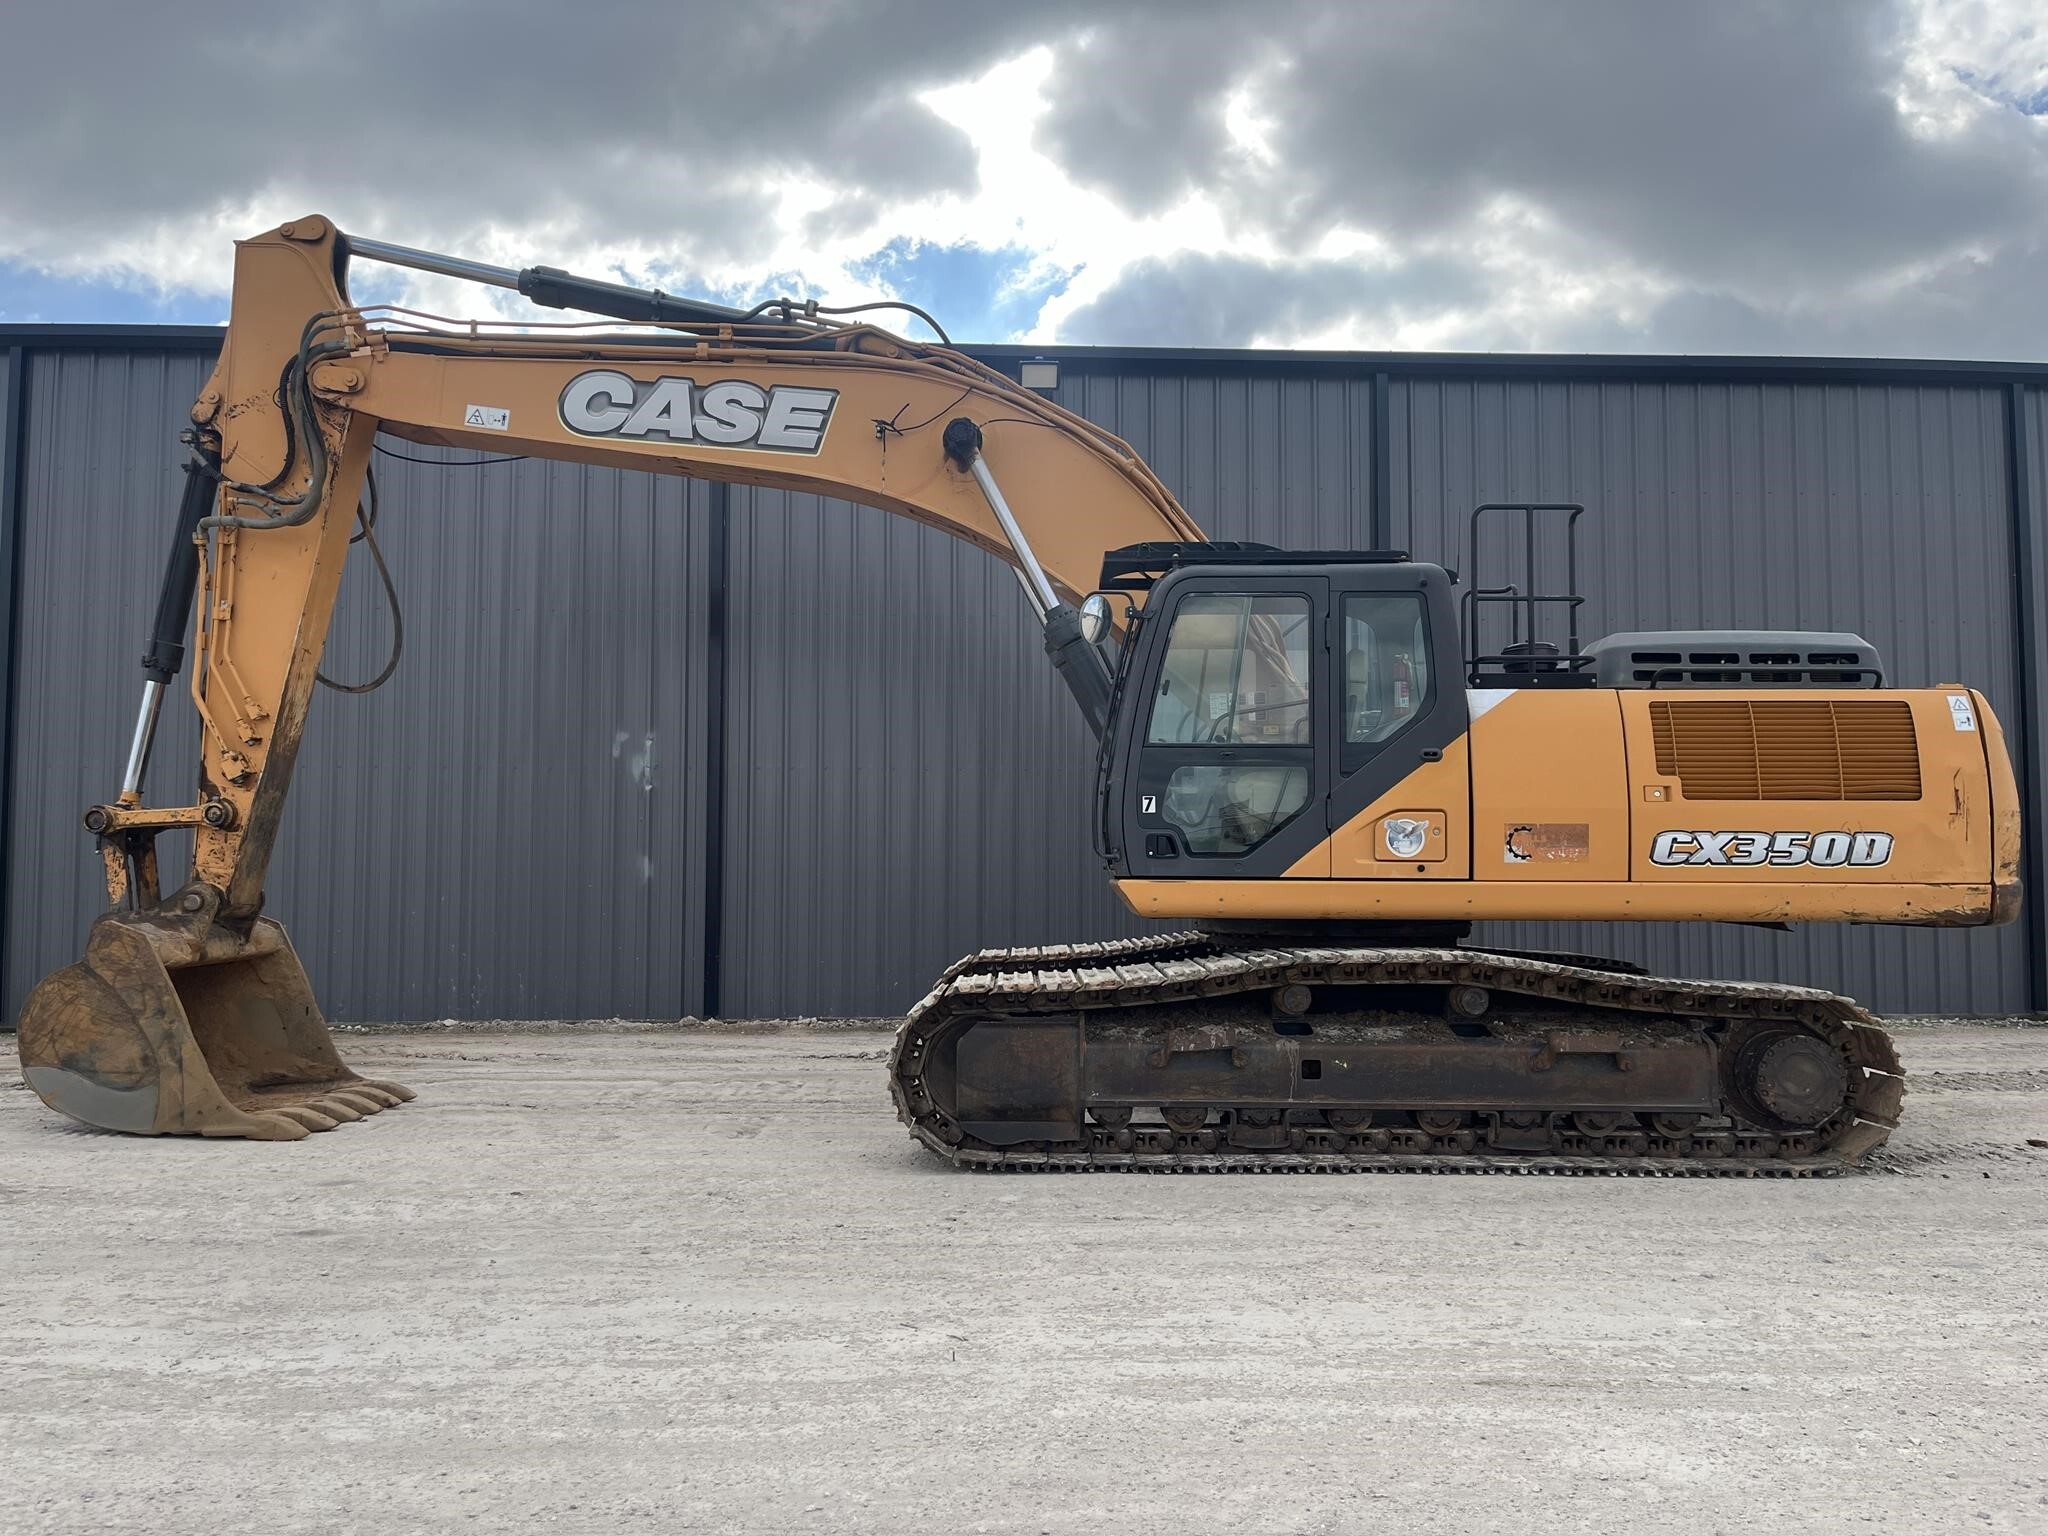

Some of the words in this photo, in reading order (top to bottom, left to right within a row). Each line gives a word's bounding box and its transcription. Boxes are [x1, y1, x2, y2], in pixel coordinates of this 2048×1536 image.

[561, 370, 836, 451] CASE
[1144, 797, 1153, 811] 7
[1651, 831, 1893, 865] CX350D
